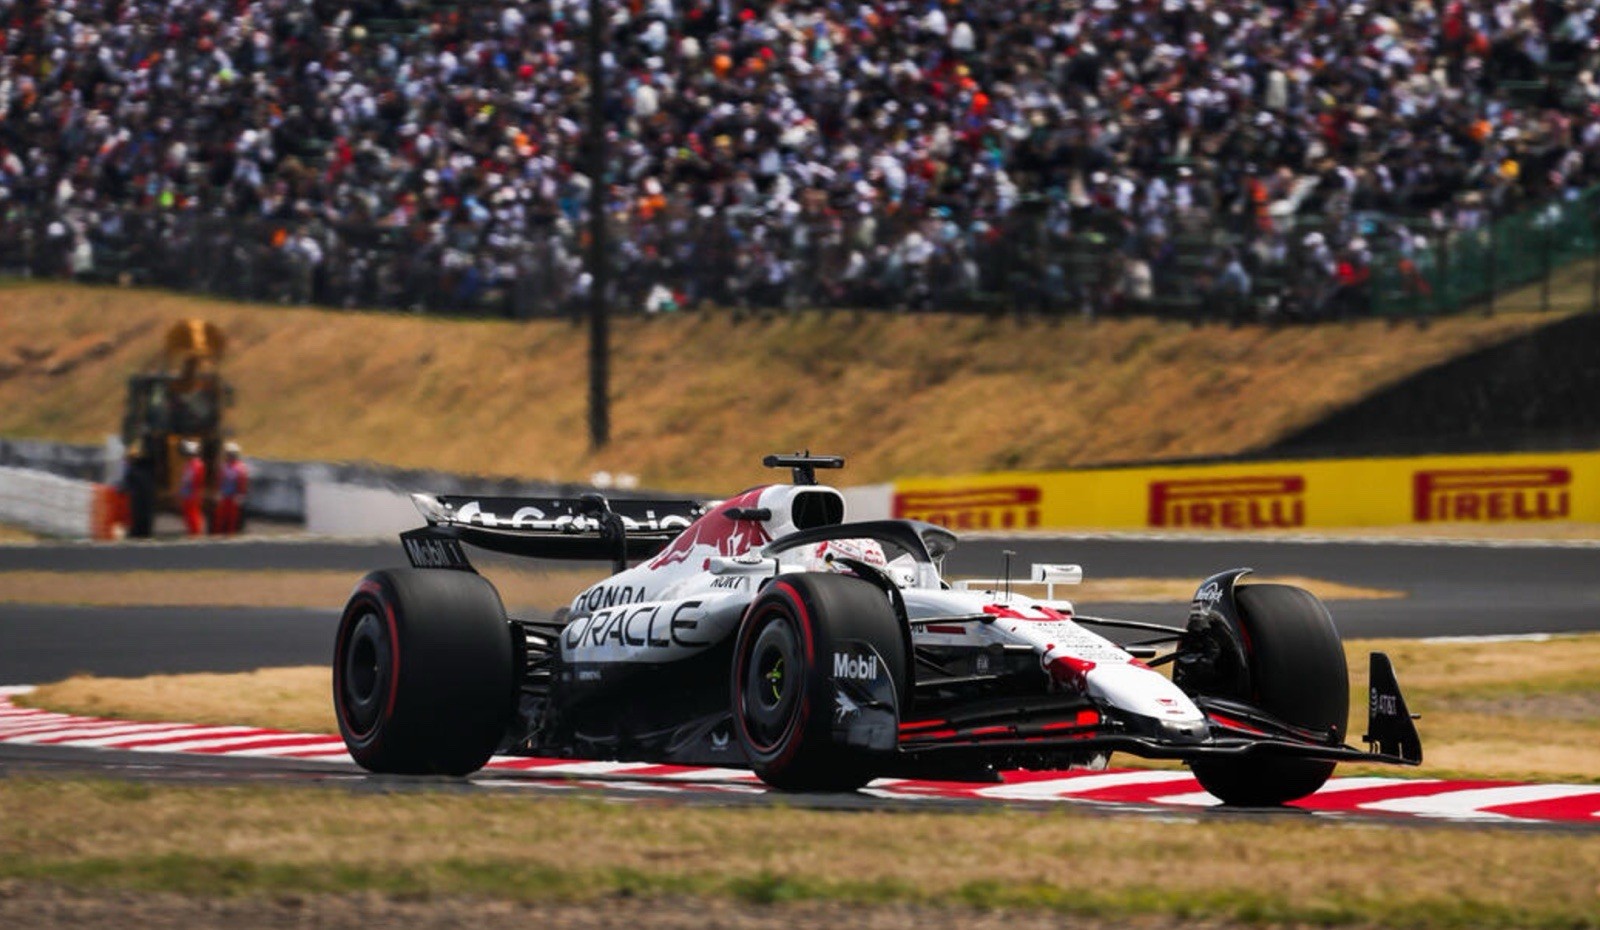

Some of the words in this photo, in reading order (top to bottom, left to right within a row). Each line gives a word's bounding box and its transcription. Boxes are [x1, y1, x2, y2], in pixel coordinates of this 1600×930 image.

[892, 484, 1041, 529] PRELLI
[1147, 475, 1305, 528] PIRELLI
[1413, 467, 1571, 521] PIRELLI
[404, 539, 451, 566] Mobil
[575, 586, 646, 611] HONDA
[566, 600, 710, 650] ORACLE
[834, 652, 877, 679] Mobil
